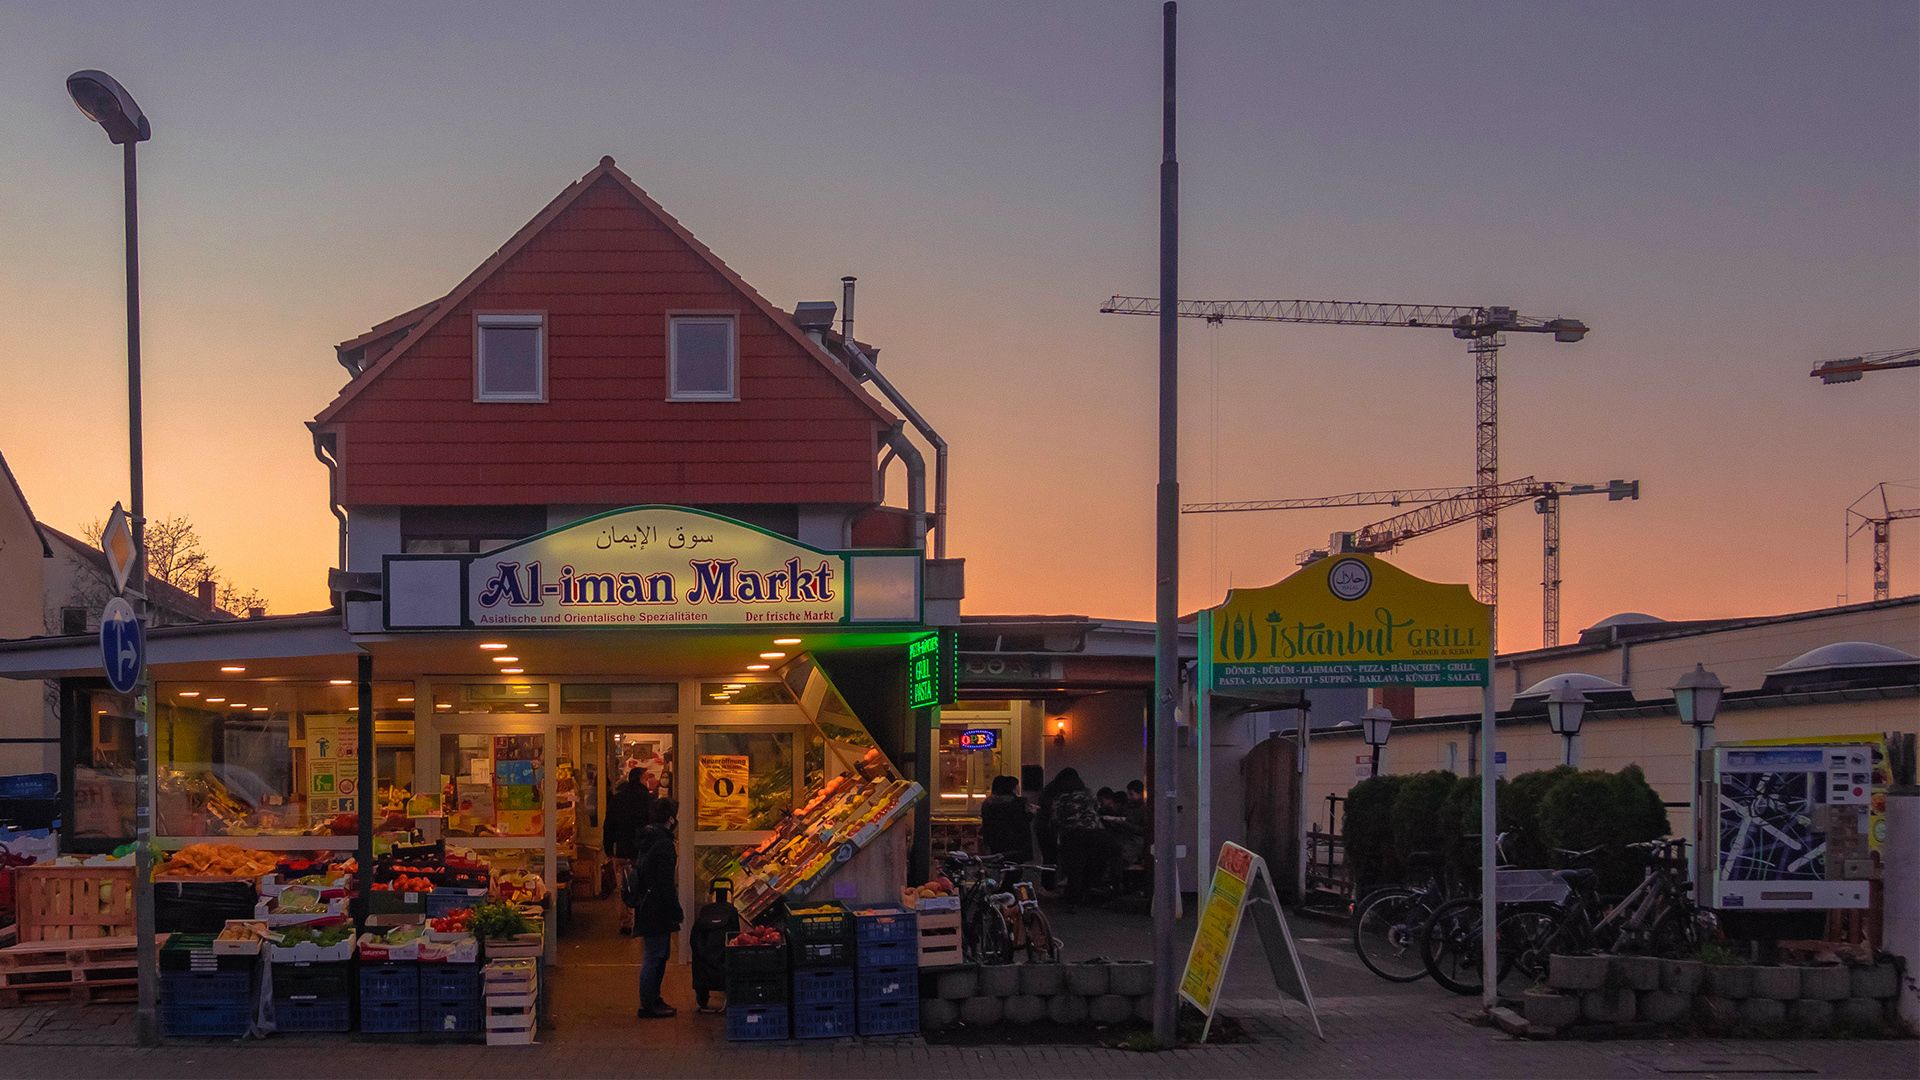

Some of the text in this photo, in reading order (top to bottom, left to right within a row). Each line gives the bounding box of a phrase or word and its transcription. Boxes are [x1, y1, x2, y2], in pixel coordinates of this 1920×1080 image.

[596, 526, 714, 550] سوق الإيمان
[480, 557, 834, 607] Al-iman Markt
[1336, 570, 1364, 584] حلال
[480, 611, 708, 624] Asiatische und Orientalische Spezialitäten
[745, 611, 834, 621] Der frische Markt
[1225, 664, 1256, 674] DÖNER
[1262, 664, 1295, 674] DÜRÜM
[1302, 665, 1352, 674] LAHMACUN
[1359, 664, 1385, 673] PIZZA
[1391, 662, 1440, 672] HÄHNCHEN
[1447, 663, 1474, 671] GRILL
[1219, 677, 1246, 685] PASTA
[1251, 676, 1312, 685] PANZAEROTTI
[1319, 675, 1352, 684] SUPPEN
[1359, 674, 1399, 683] BAKLAVA
[1405, 672, 1440, 682] KÜNEFE
[1447, 673, 1481, 682] SALATE
[915, 680, 932, 702] PASTA
